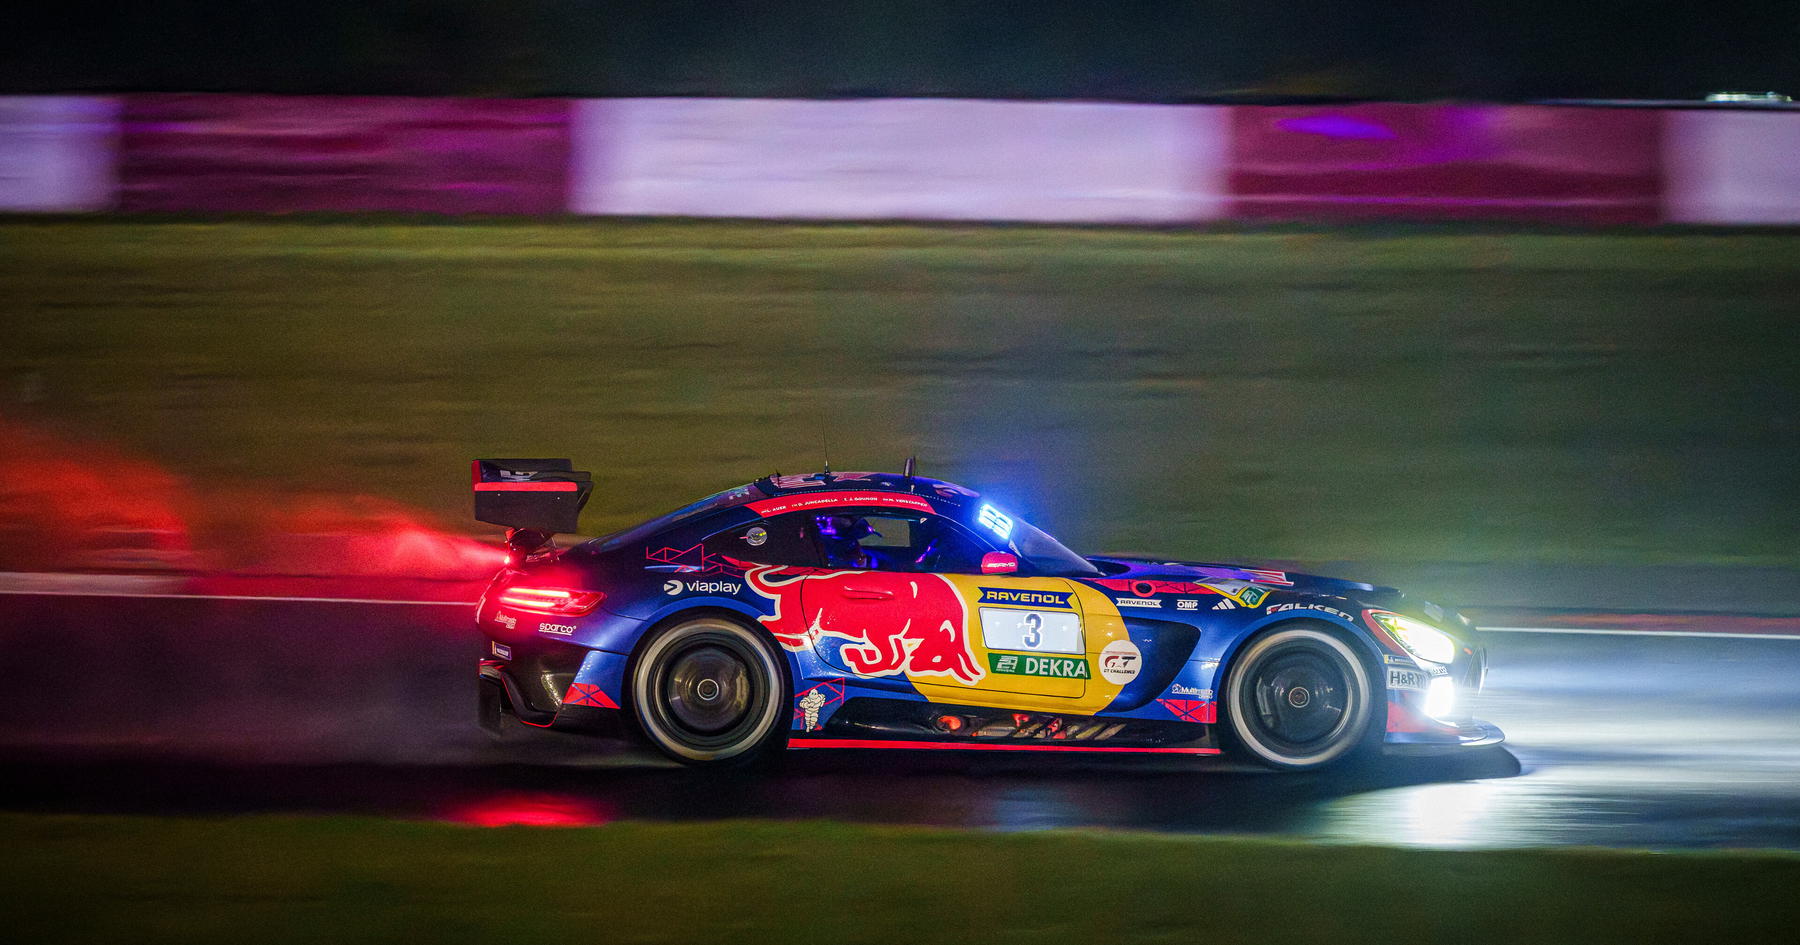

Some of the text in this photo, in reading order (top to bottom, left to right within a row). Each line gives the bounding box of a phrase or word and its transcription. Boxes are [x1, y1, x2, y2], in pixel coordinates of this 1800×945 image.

[686, 580, 742, 596] viaplay
[985, 590, 1066, 605] RAVENOL
[1120, 599, 1159, 607] RAVENOL
[1176, 601, 1199, 609] OMP
[1266, 602, 1354, 622] FALKEN
[539, 622, 574, 634] sparco
[1022, 612, 1044, 650] 3
[1024, 657, 1089, 679] DEKRA
